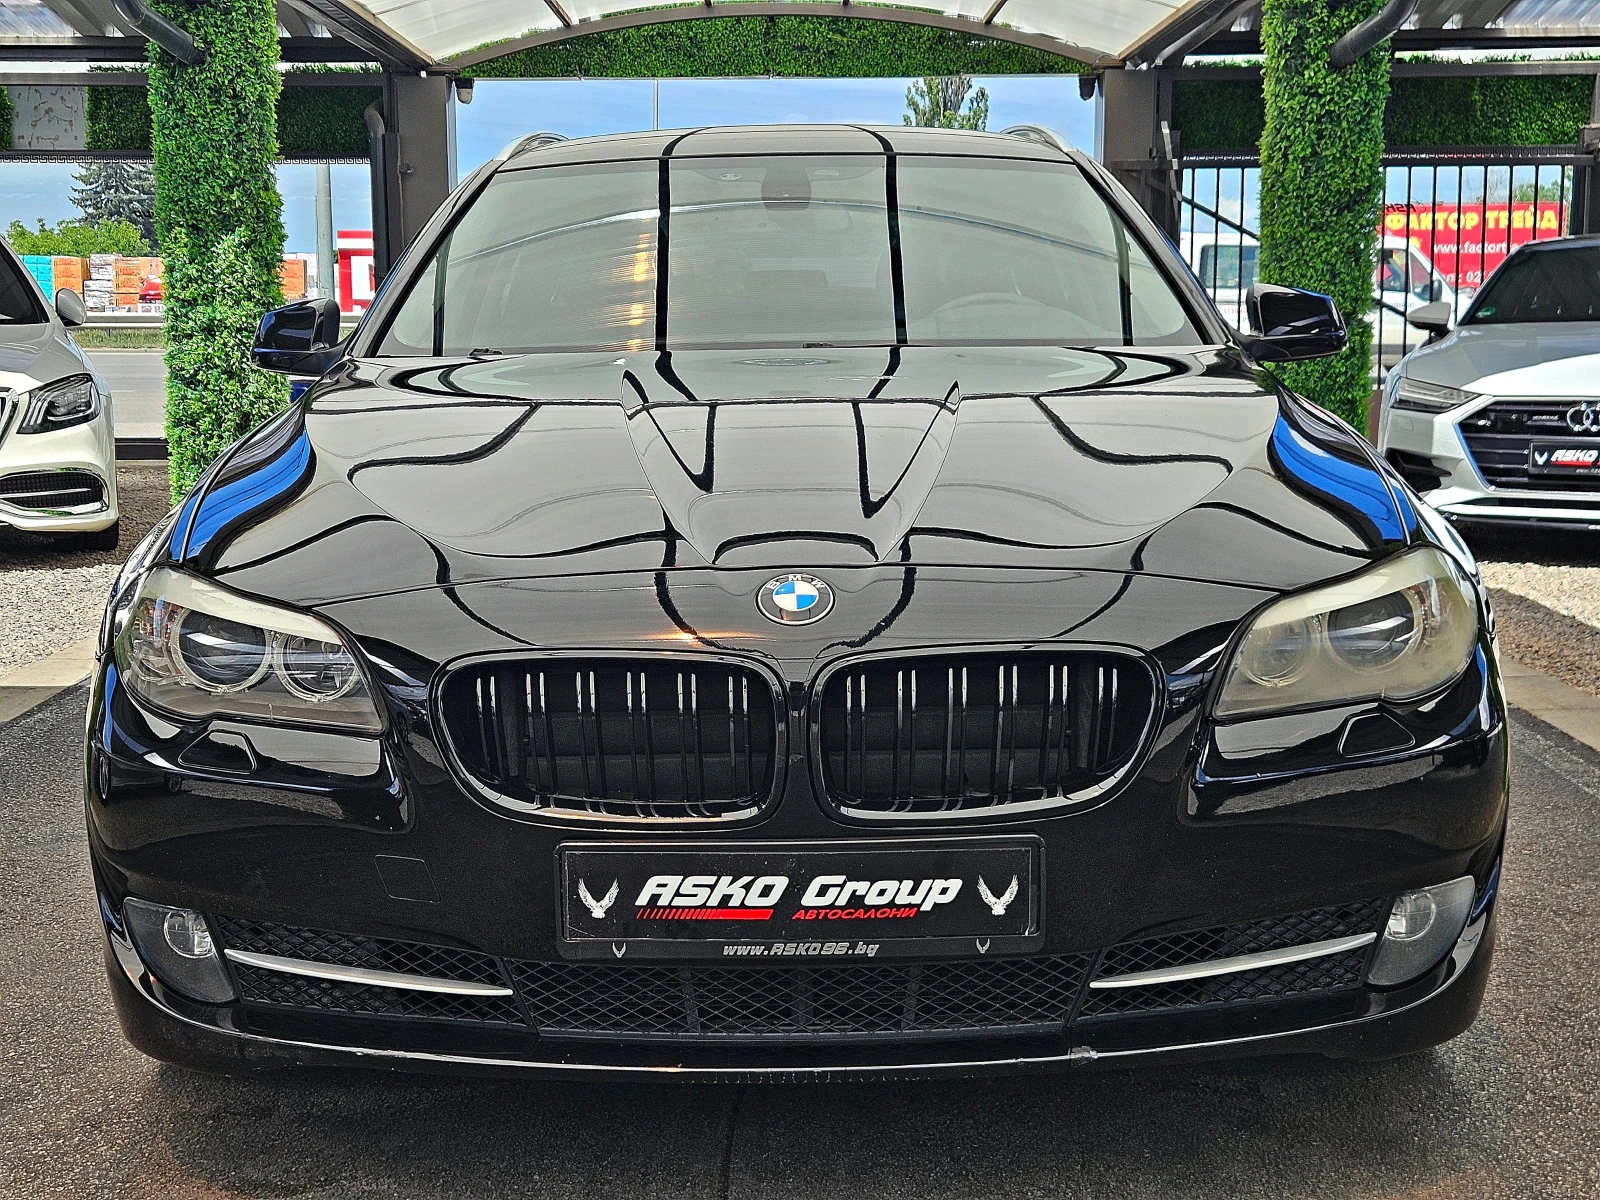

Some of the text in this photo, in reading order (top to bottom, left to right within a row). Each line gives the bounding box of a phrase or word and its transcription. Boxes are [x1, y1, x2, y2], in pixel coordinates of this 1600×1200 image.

[1385, 204, 1558, 230] ФАКТОР ТРЕЙД
[1550, 449, 1599, 462] ASKO
[766, 574, 826, 590] BMW
[634, 874, 963, 911] ASKO Group
[792, 907, 918, 920] АВТОСАЛОНИ
